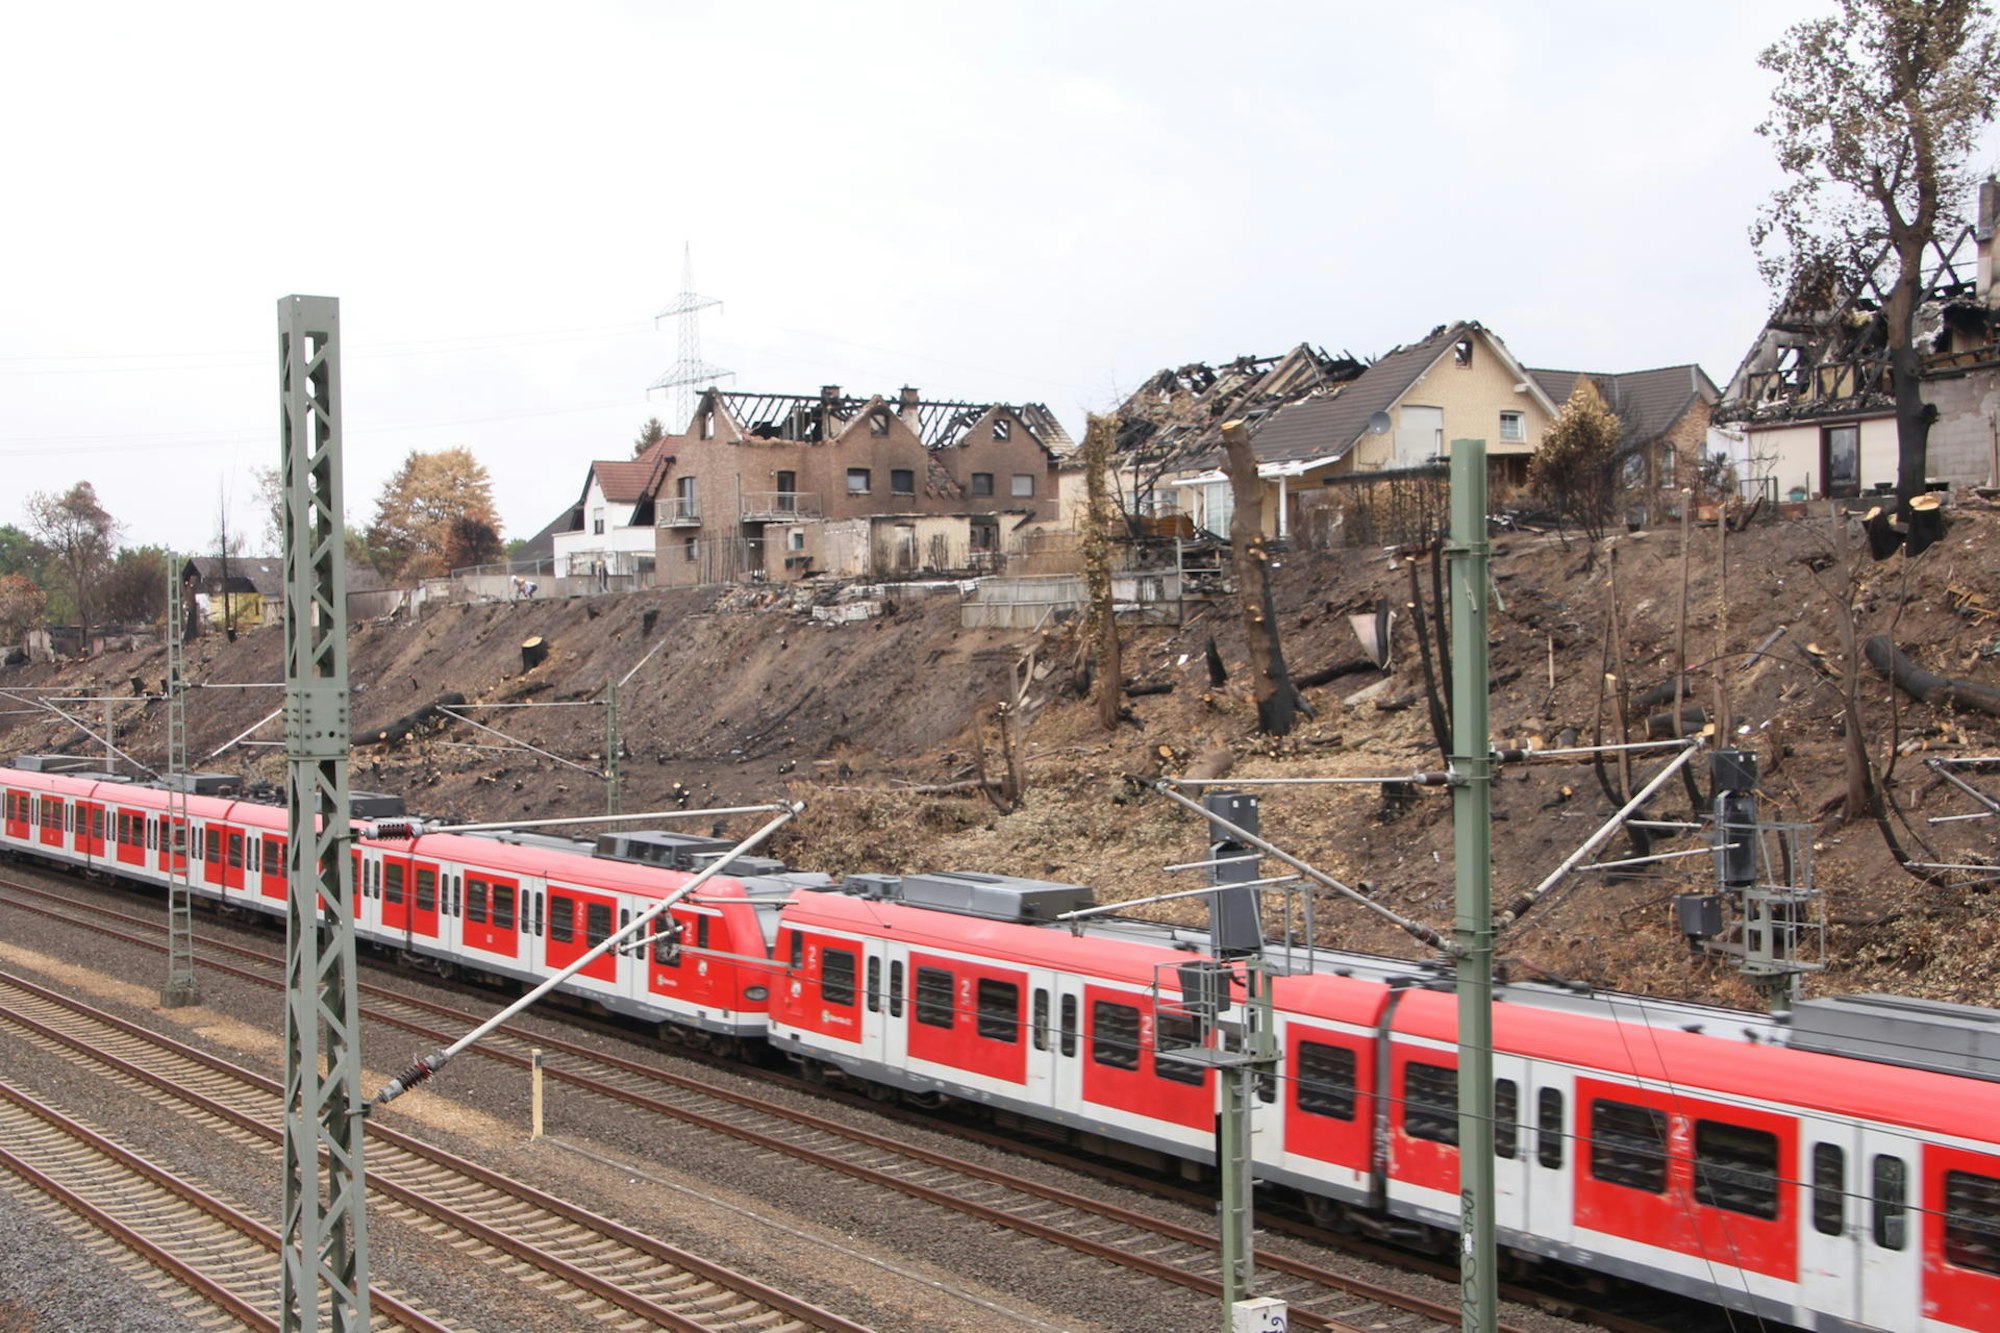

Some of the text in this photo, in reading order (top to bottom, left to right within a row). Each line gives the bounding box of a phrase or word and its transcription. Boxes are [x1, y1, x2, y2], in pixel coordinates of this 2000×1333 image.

[808, 946, 817, 962] 2
[961, 979, 970, 997] 2
[1141, 1015, 1153, 1034] 2
[1671, 1115, 1690, 1140] 2
